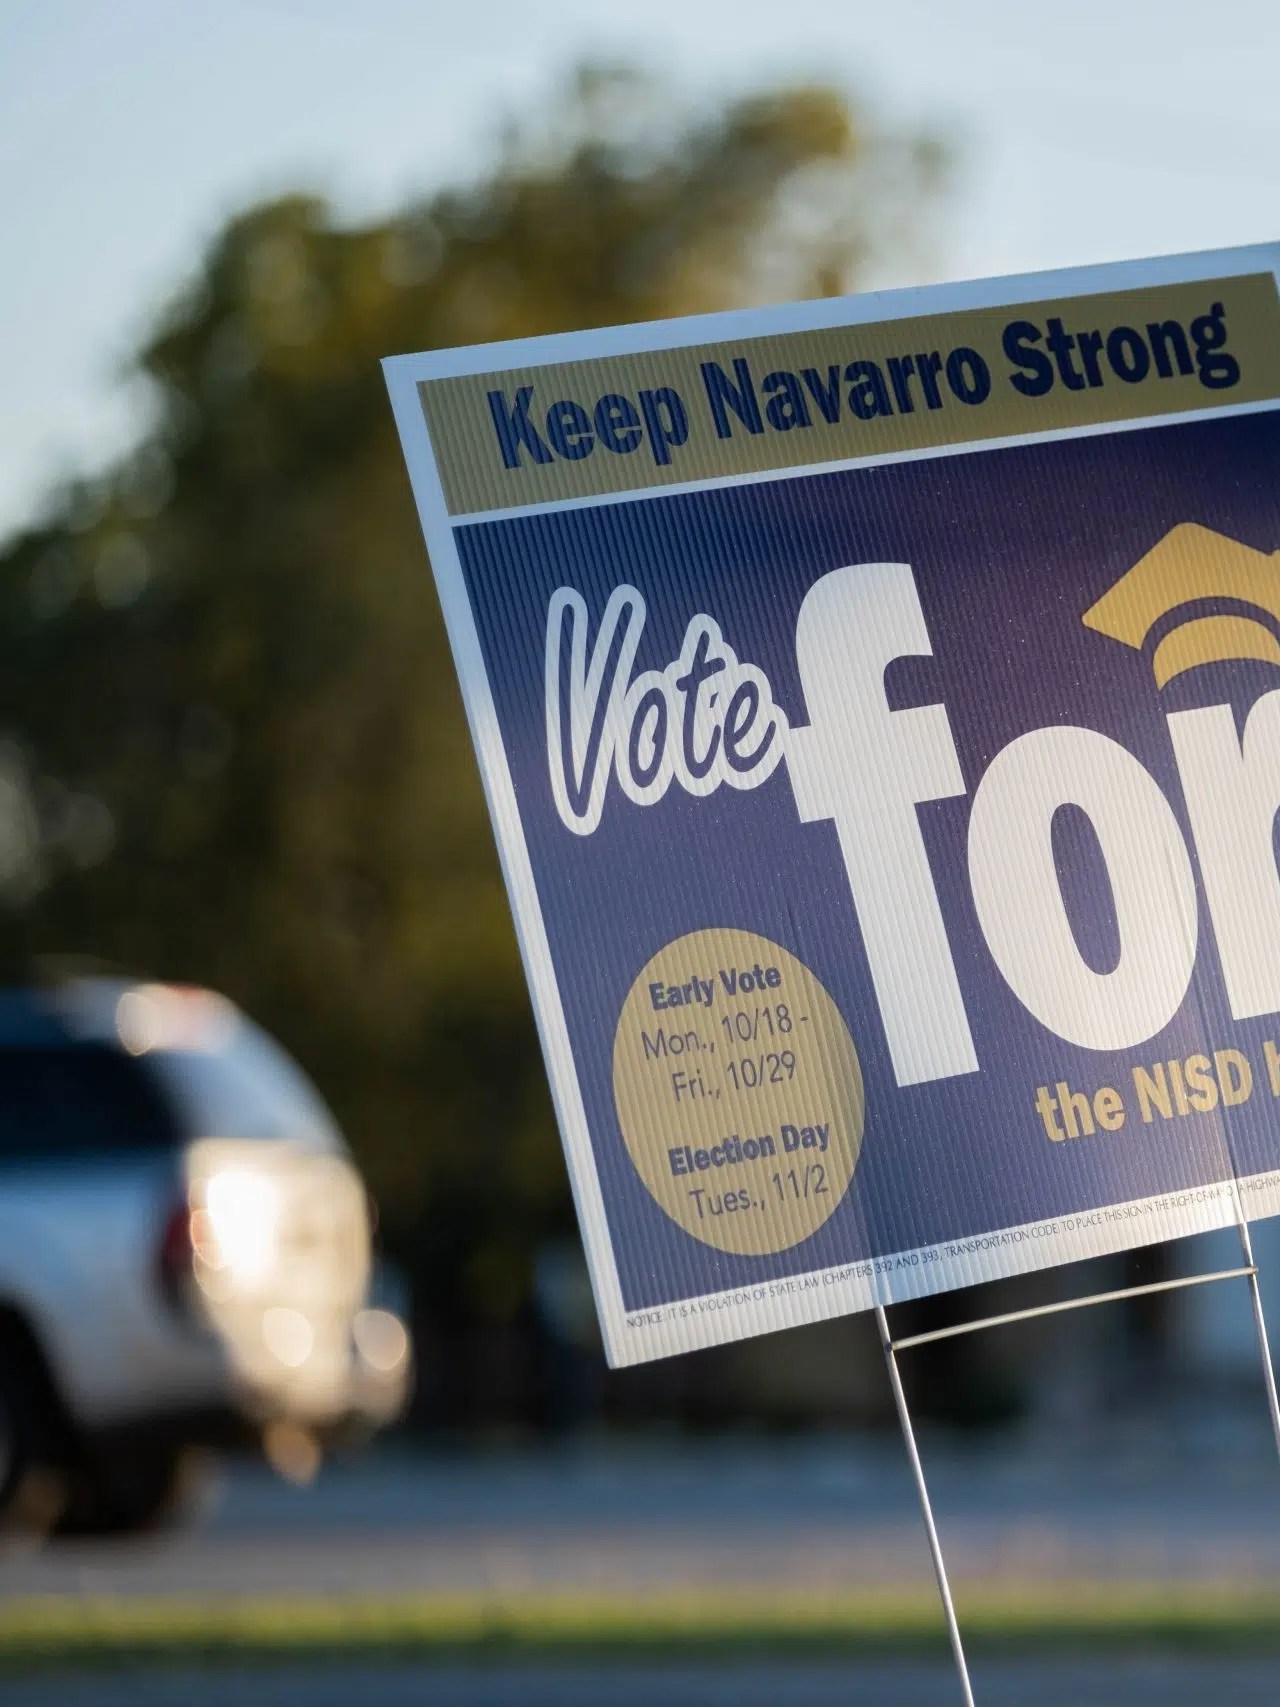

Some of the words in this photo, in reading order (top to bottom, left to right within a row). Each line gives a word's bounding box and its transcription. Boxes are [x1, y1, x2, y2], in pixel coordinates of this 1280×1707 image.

[487, 381, 690, 469] Keep
[699, 344, 992, 439] Navarro
[1000, 302, 1240, 397] Strong
[545, 583, 790, 836] Vote
[649, 975, 715, 1010] Early
[719, 964, 782, 996] Vote
[641, 1029, 715, 1060] Mon.,
[721, 1004, 793, 1045] 10/18
[672, 1069, 720, 1102] Fri.,
[727, 1050, 796, 1090] 10/29
[1035, 1081, 1126, 1142] the
[1132, 1048, 1253, 1123] NISD
[668, 1135, 776, 1176] Election
[780, 1122, 830, 1153] Day
[689, 1187, 766, 1219] Tues.,
[772, 1163, 829, 1201] 11/2
[667, 1308, 677, 1319] IT
[678, 1306, 688, 1317] IS
[689, 1303, 699, 1314] A
[698, 1291, 752, 1312] VIOLATION
[752, 1288, 767, 1300] OF
[769, 1282, 796, 1296] STATE
[798, 1276, 820, 1290] LAW
[821, 1264, 874, 1285] (CHAPTERS
[874, 1260, 894, 1273] 392
[895, 1254, 920, 1268] AND
[920, 1249, 942, 1263] 393,
[944, 1229, 1030, 1258] TRANSPORTATION
[1060, 1219, 1076, 1232] TO
[1075, 1213, 1103, 1228] PLACE
[1103, 1209, 1123, 1222] THIS
[1123, 1205, 1143, 1218] SIGN
[1143, 1202, 1154, 1213] IN
[1154, 1199, 1171, 1211] THE
